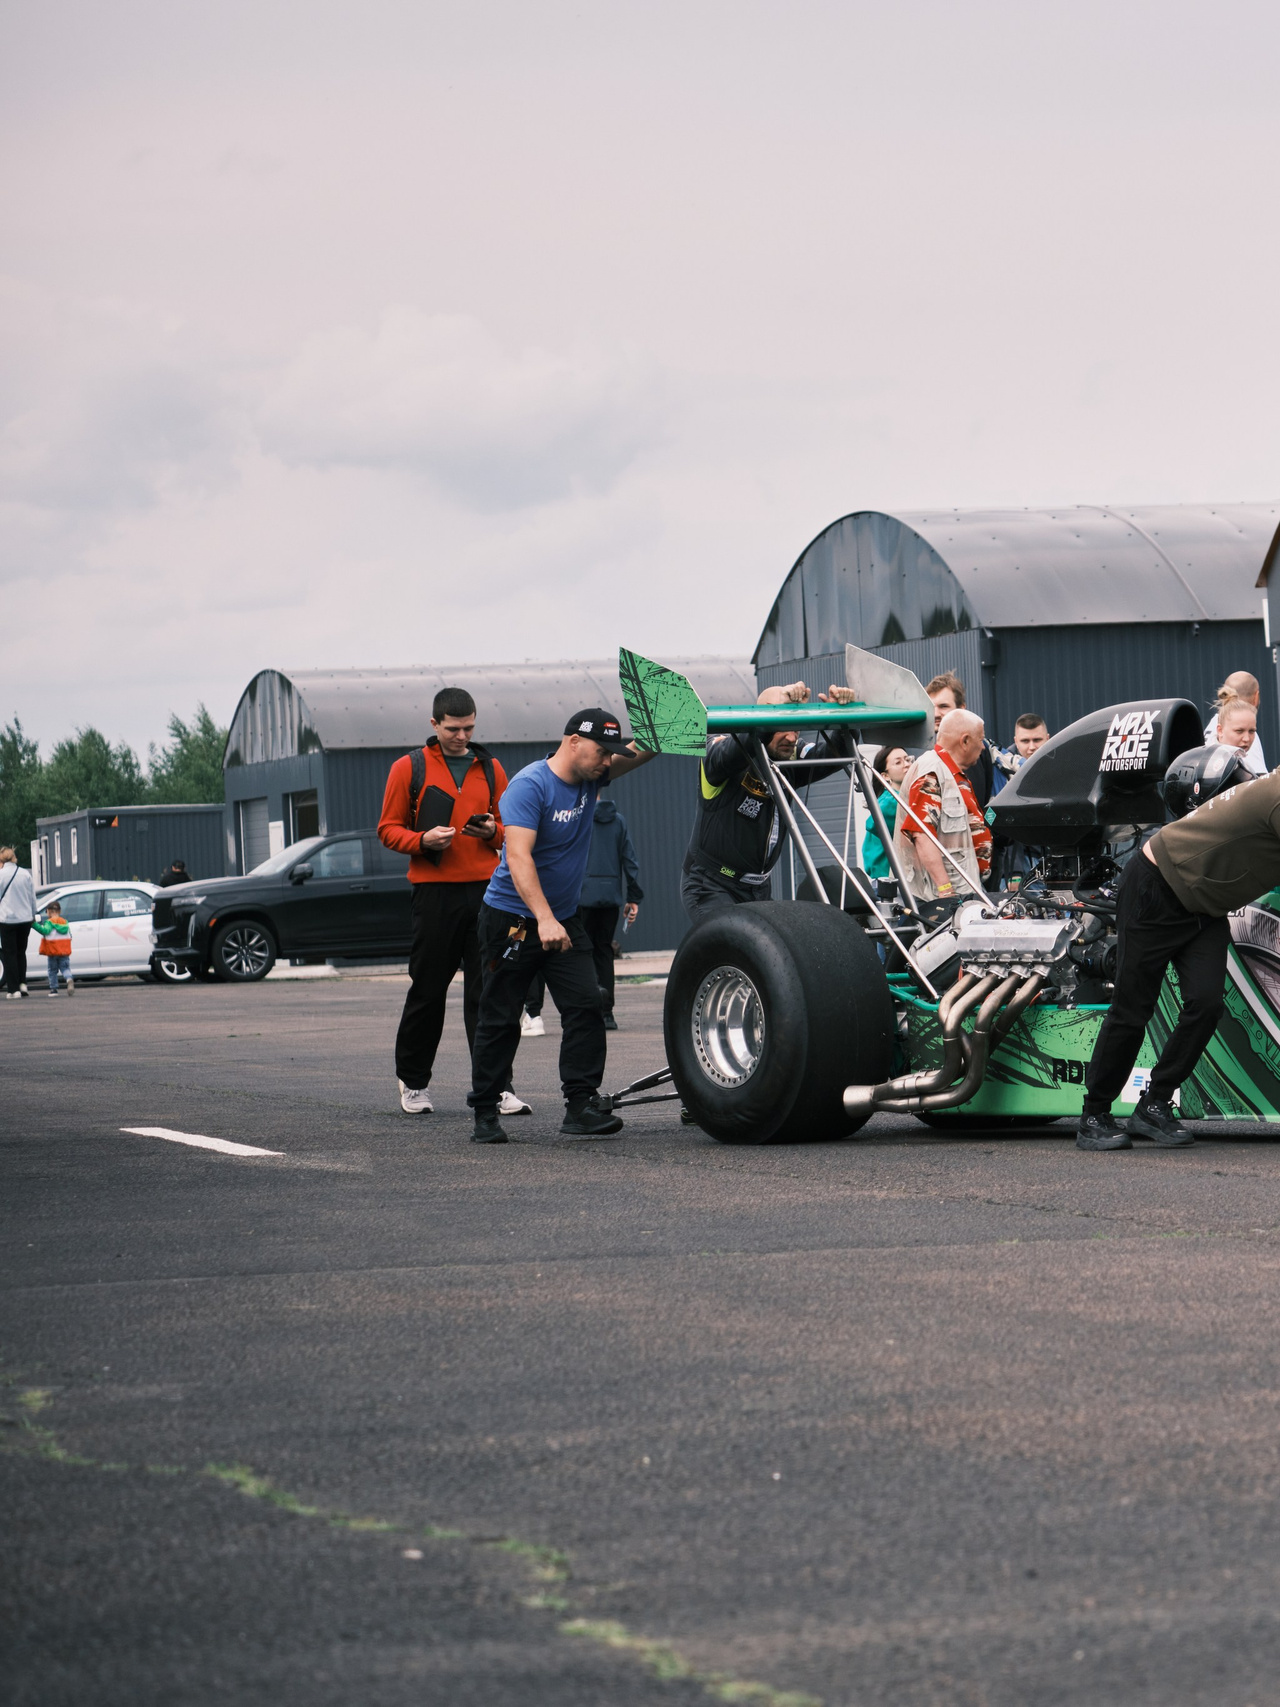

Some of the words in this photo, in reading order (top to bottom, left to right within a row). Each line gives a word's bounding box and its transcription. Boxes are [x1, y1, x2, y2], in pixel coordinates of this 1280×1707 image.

[1107, 710, 1161, 736] MAX
[1101, 733, 1153, 760] RIDE
[1098, 757, 1148, 772] MOTORSPORT
